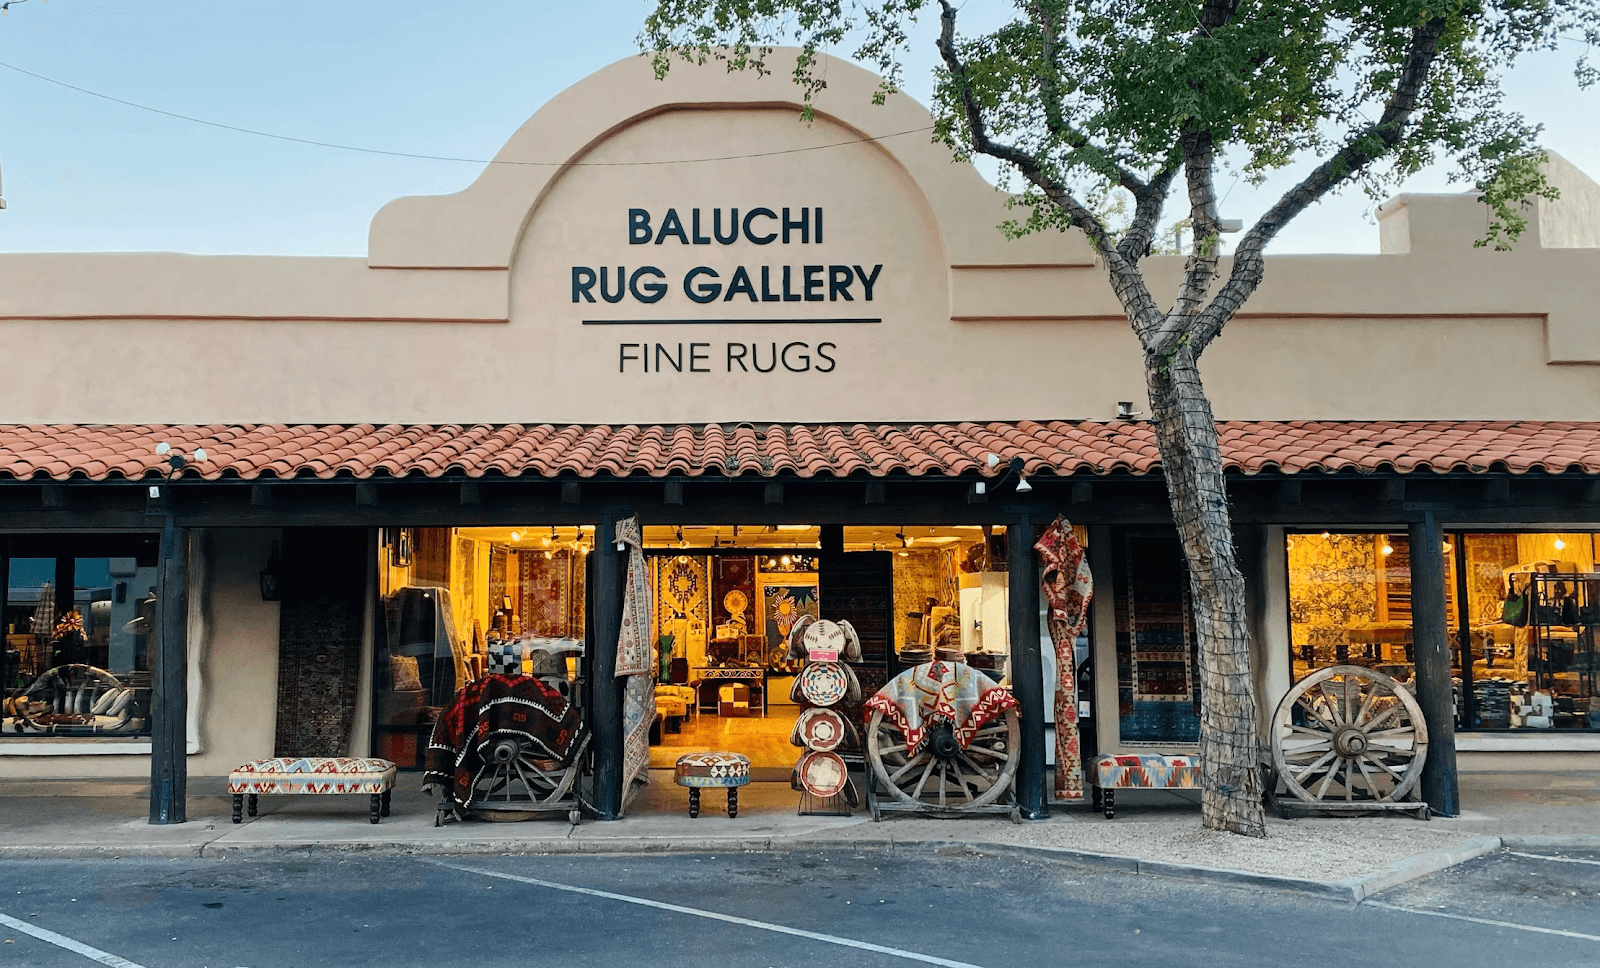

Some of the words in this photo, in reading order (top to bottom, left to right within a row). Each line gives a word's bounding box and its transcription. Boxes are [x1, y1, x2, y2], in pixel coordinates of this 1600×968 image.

[628, 207, 823, 245] BALUCHI
[571, 266, 668, 303] RUG
[683, 264, 883, 303] GALLERY
[619, 343, 711, 372] FINE
[727, 341, 837, 372] RUGS
